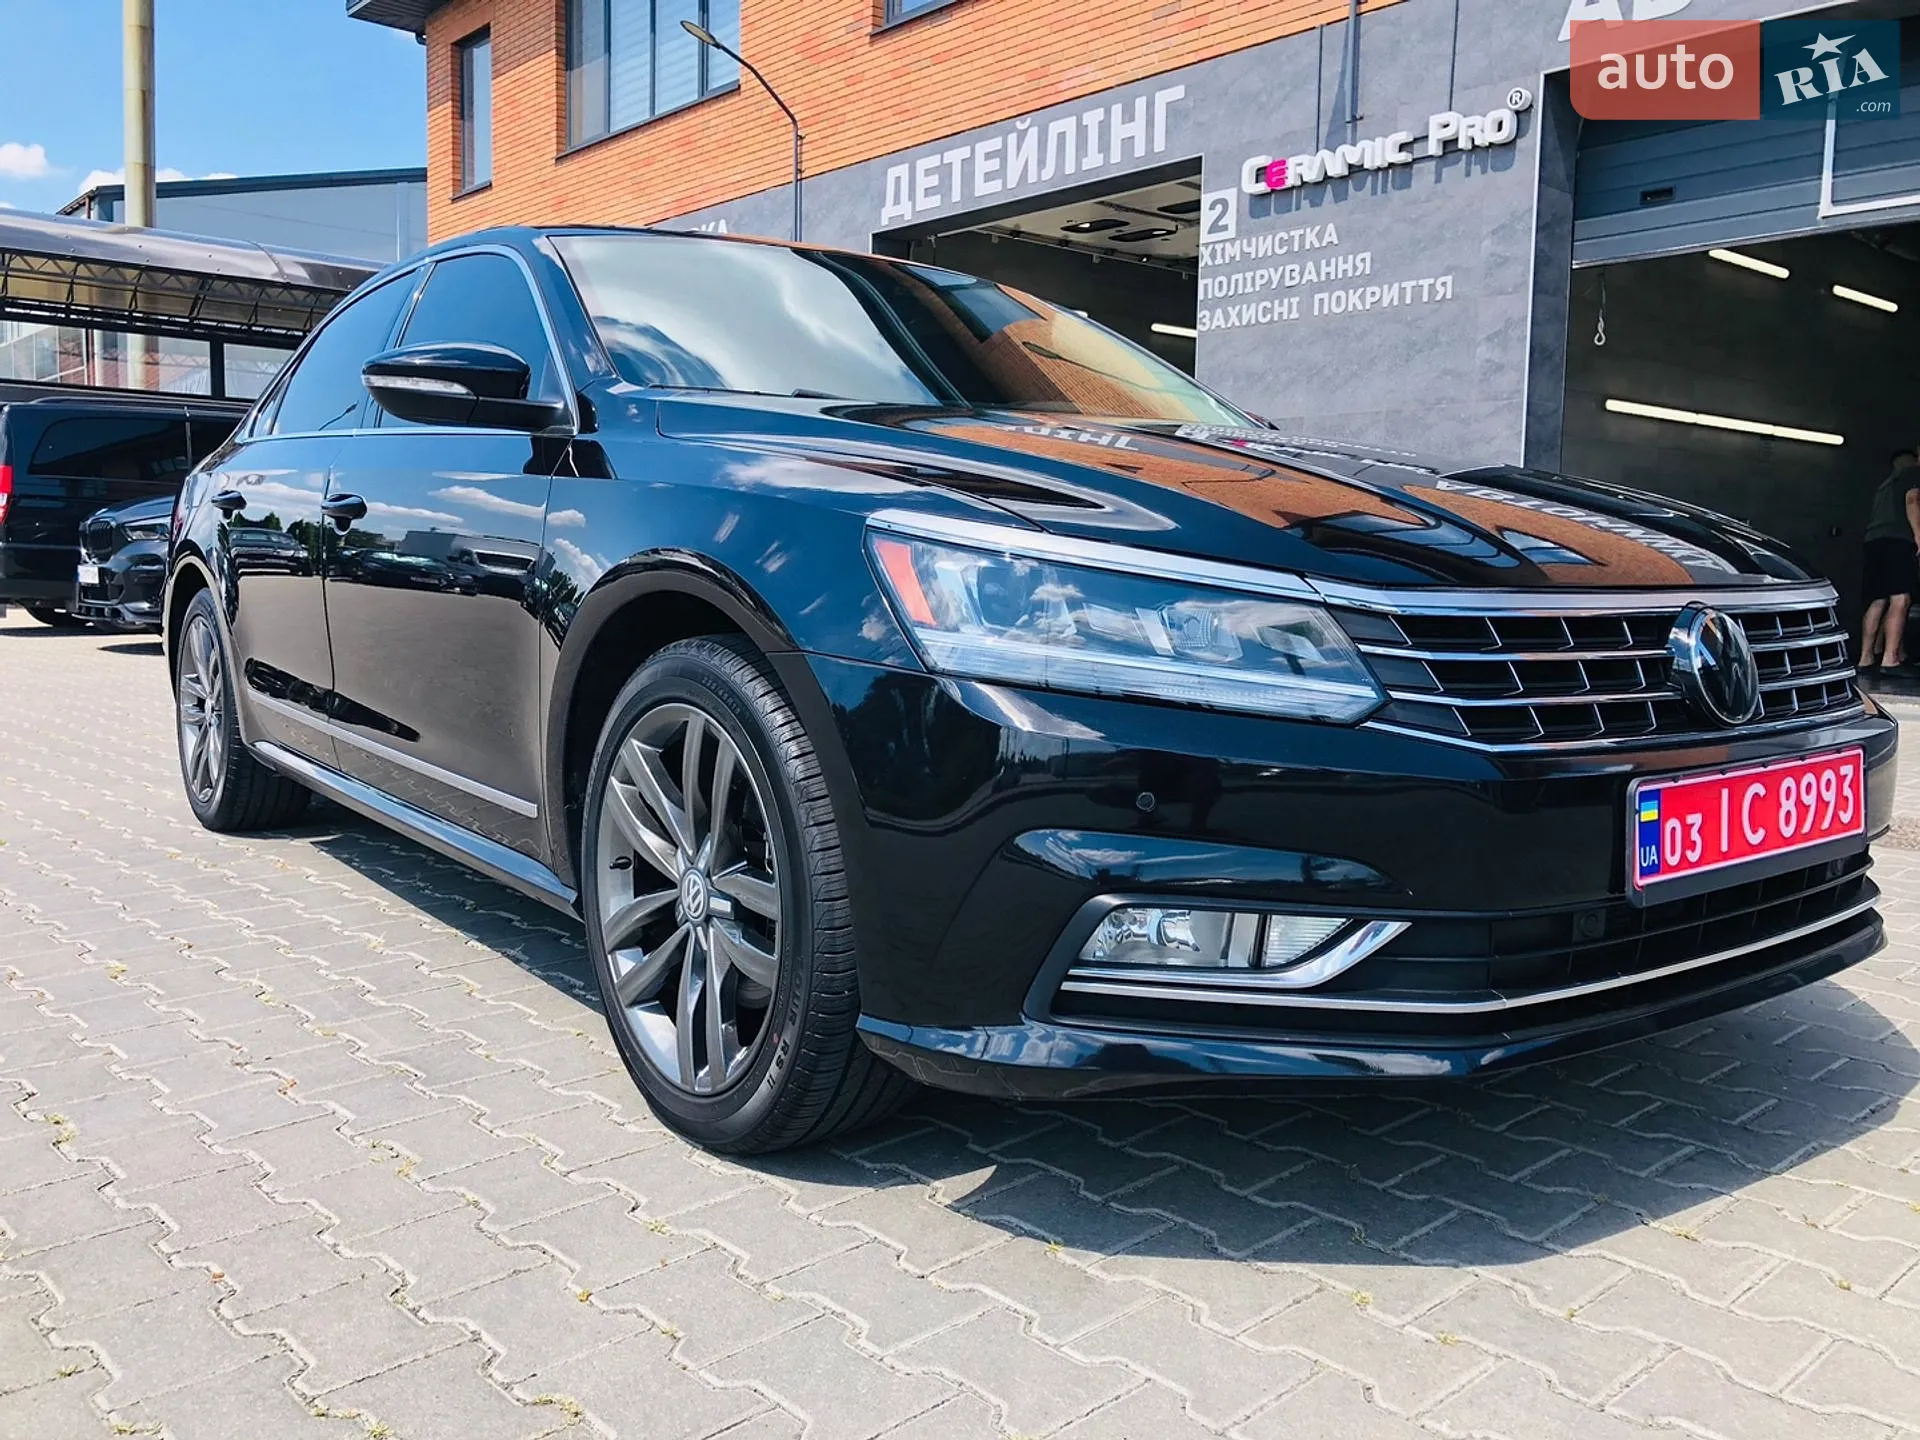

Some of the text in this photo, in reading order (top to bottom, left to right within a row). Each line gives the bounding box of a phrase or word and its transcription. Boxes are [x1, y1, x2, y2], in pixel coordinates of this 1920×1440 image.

[880, 84, 1186, 227] ДЕТЕЙЛІНГ
[1207, 197, 1231, 236] 2
[1200, 222, 1340, 268] ХІМЧИСТКА
[1198, 251, 1373, 301] ПОЛІРУВАННЯ
[1197, 275, 1454, 333] ЗАХИСНІ ПОКРИТТЯ
[1663, 763, 1855, 867] 03 IC 8993
[1640, 845, 1659, 868] UA
